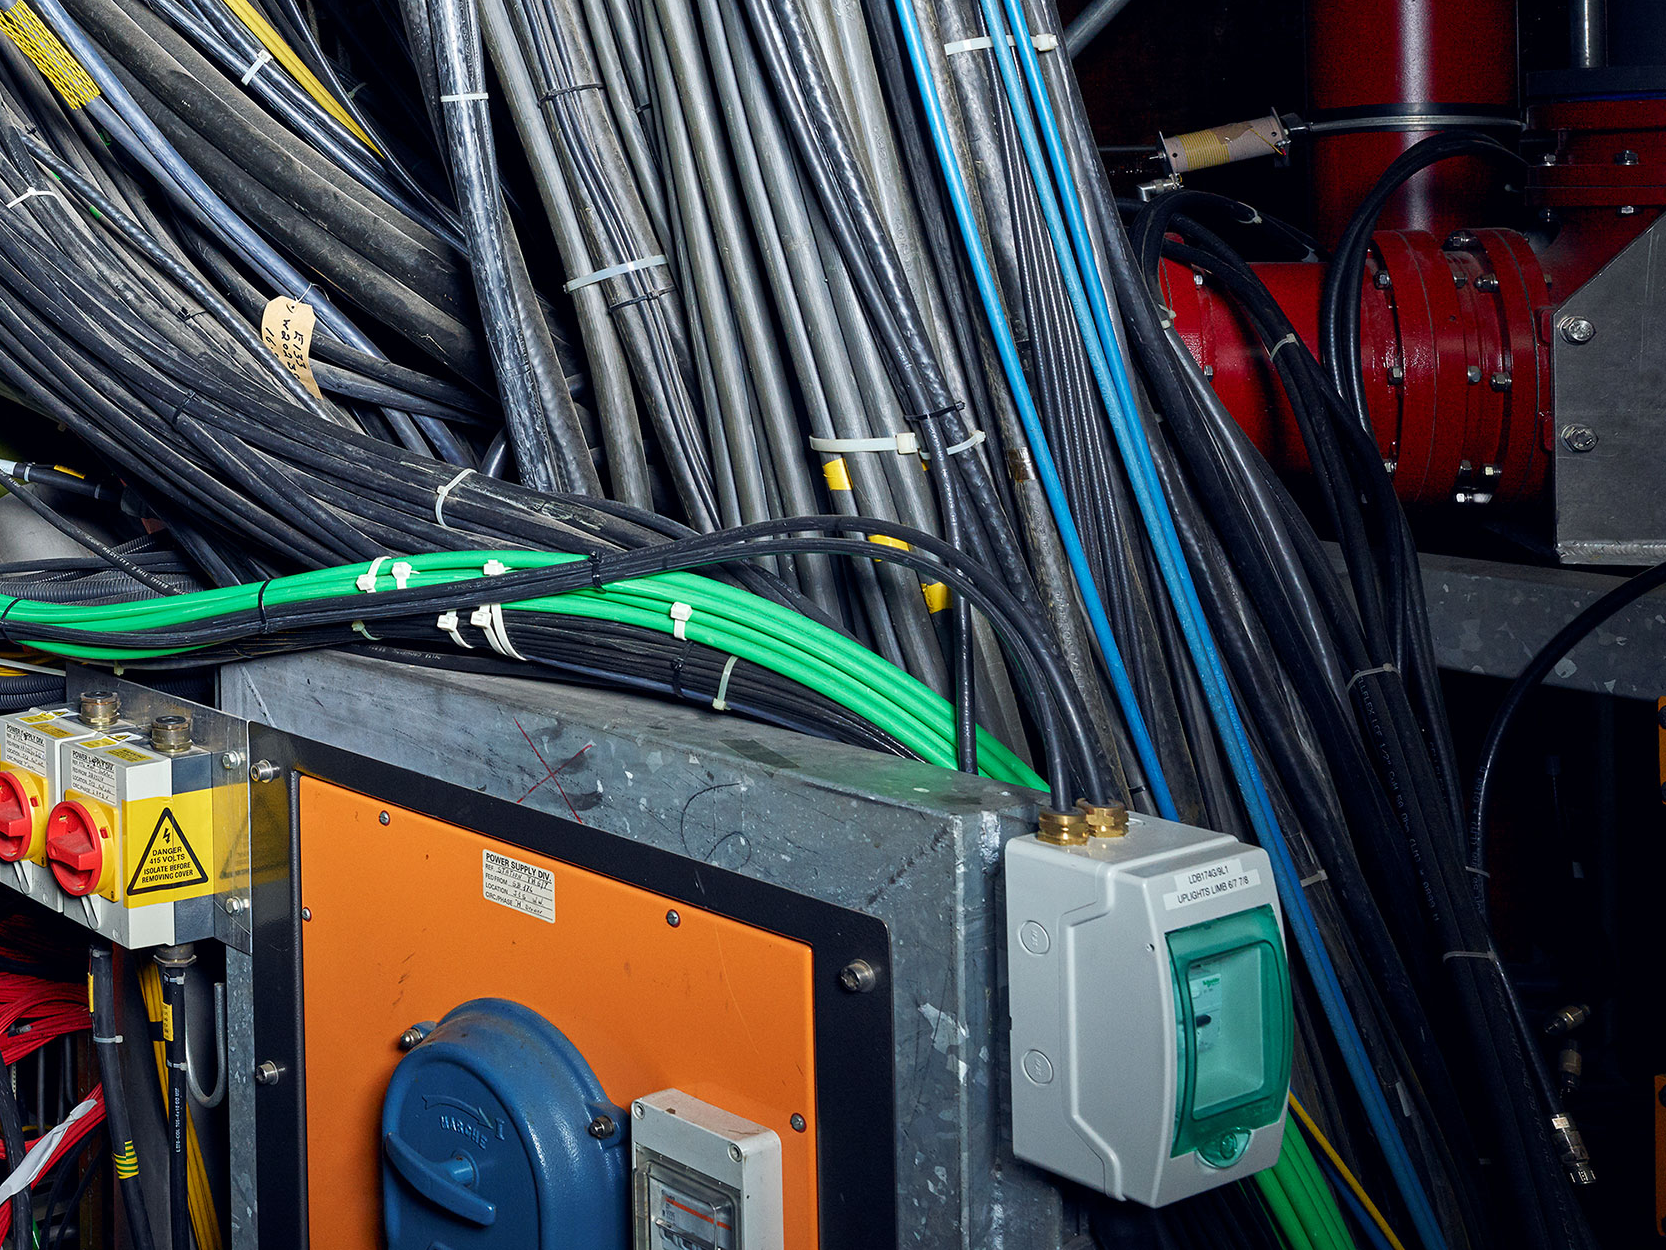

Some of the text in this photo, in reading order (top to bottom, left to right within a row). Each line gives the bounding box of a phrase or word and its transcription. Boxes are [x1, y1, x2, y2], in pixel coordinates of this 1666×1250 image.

[72, 750, 87, 761] POWER
[152, 846, 182, 857] DANGER
[162, 853, 185, 863] VOLTS
[143, 862, 191, 875] ISOLATE BEFORE
[486, 853, 552, 882] POWER SUPPLY DIV.
[142, 869, 194, 883] REMOVING COVER
[485, 882, 508, 894] LOCATION
[1177, 875, 1250, 904] UPLIGHTS LIMB 6/7 7/8
[440, 1115, 488, 1150] MARCHE
